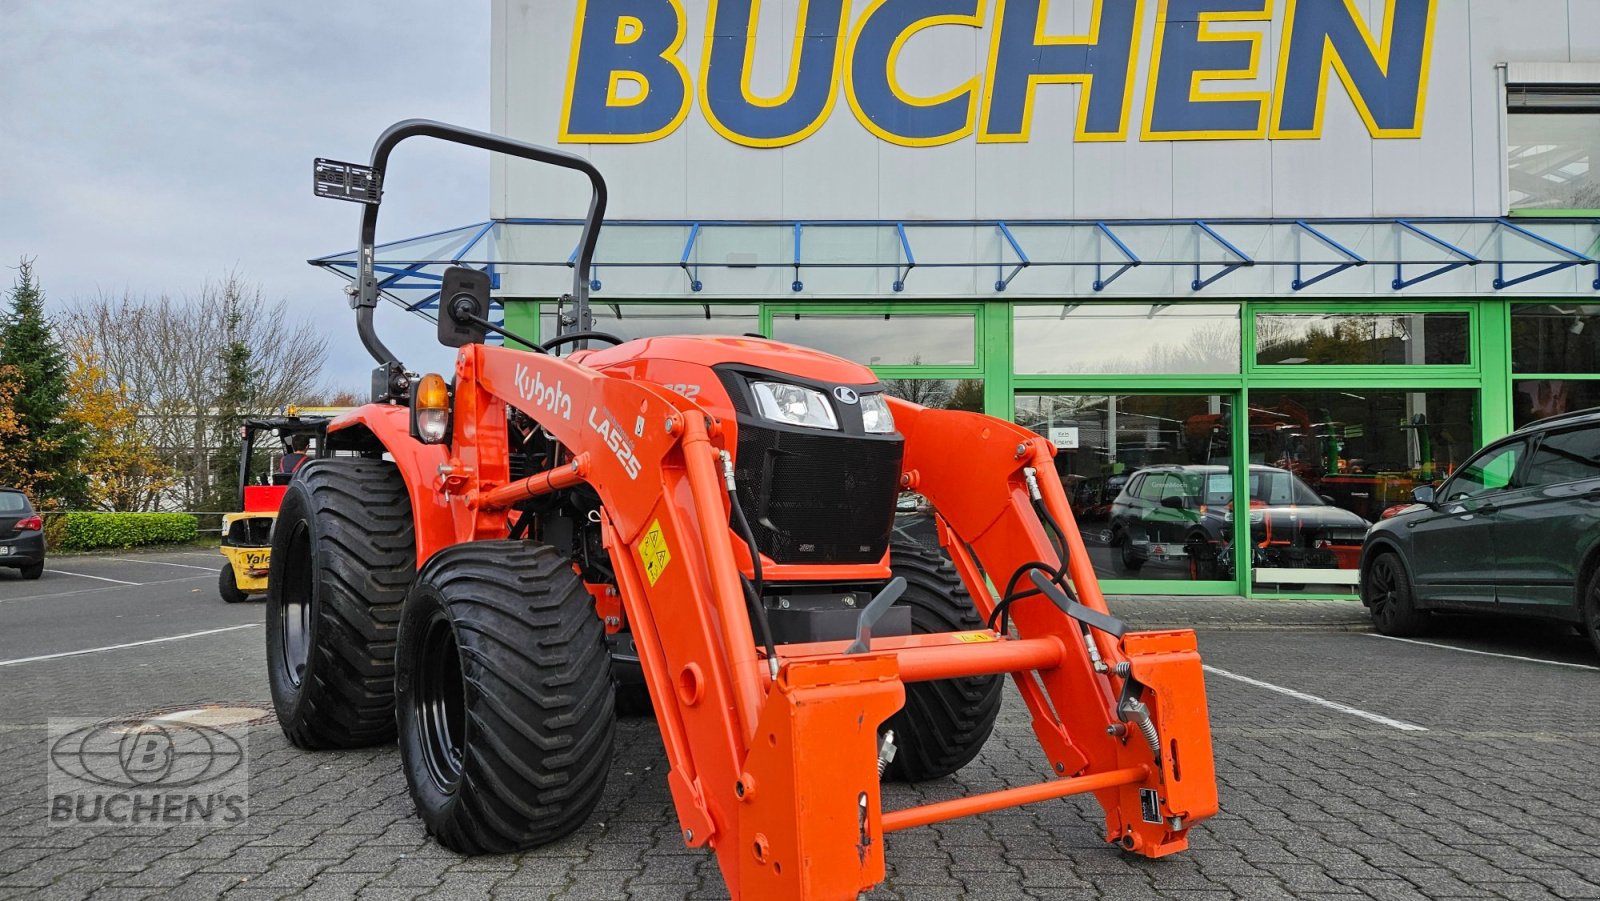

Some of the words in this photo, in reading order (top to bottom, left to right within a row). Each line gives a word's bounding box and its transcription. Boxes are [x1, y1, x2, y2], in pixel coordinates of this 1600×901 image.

[558, 0, 1437, 148] BUCHEN
[514, 362, 572, 420] Kubota
[588, 406, 642, 481] LA525
